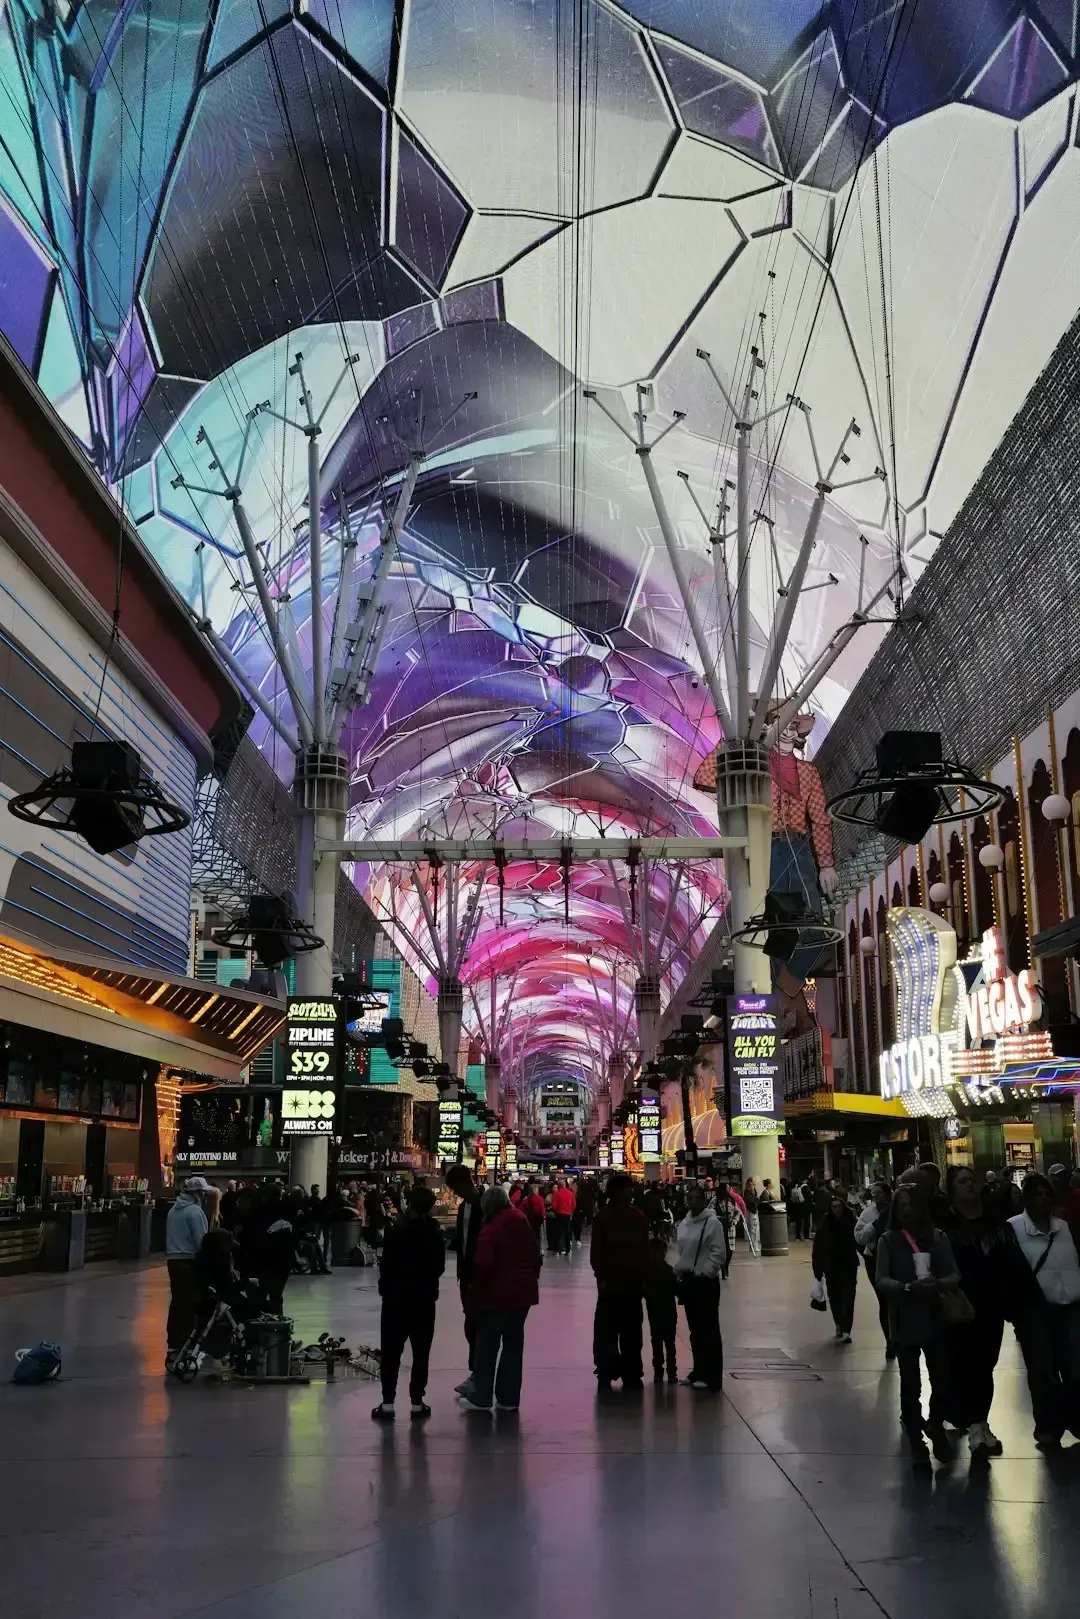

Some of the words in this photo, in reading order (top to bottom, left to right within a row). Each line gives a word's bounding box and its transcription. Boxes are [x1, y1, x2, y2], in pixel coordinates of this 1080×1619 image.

[966, 969, 1042, 1040] VEGAS
[288, 1028, 335, 1041] ZIPLINE
[734, 1036, 752, 1048] ALL
[754, 1035, 775, 1047] YOU
[734, 1047, 755, 1058] CAN
[757, 1047, 776, 1058] FLY
[291, 1048, 330, 1074] $39
[283, 1120, 317, 1130] ALWAYS
[317, 1120, 333, 1130] ON
[190, 1151, 222, 1161] ROTATING
[222, 1151, 237, 1161] BAR
